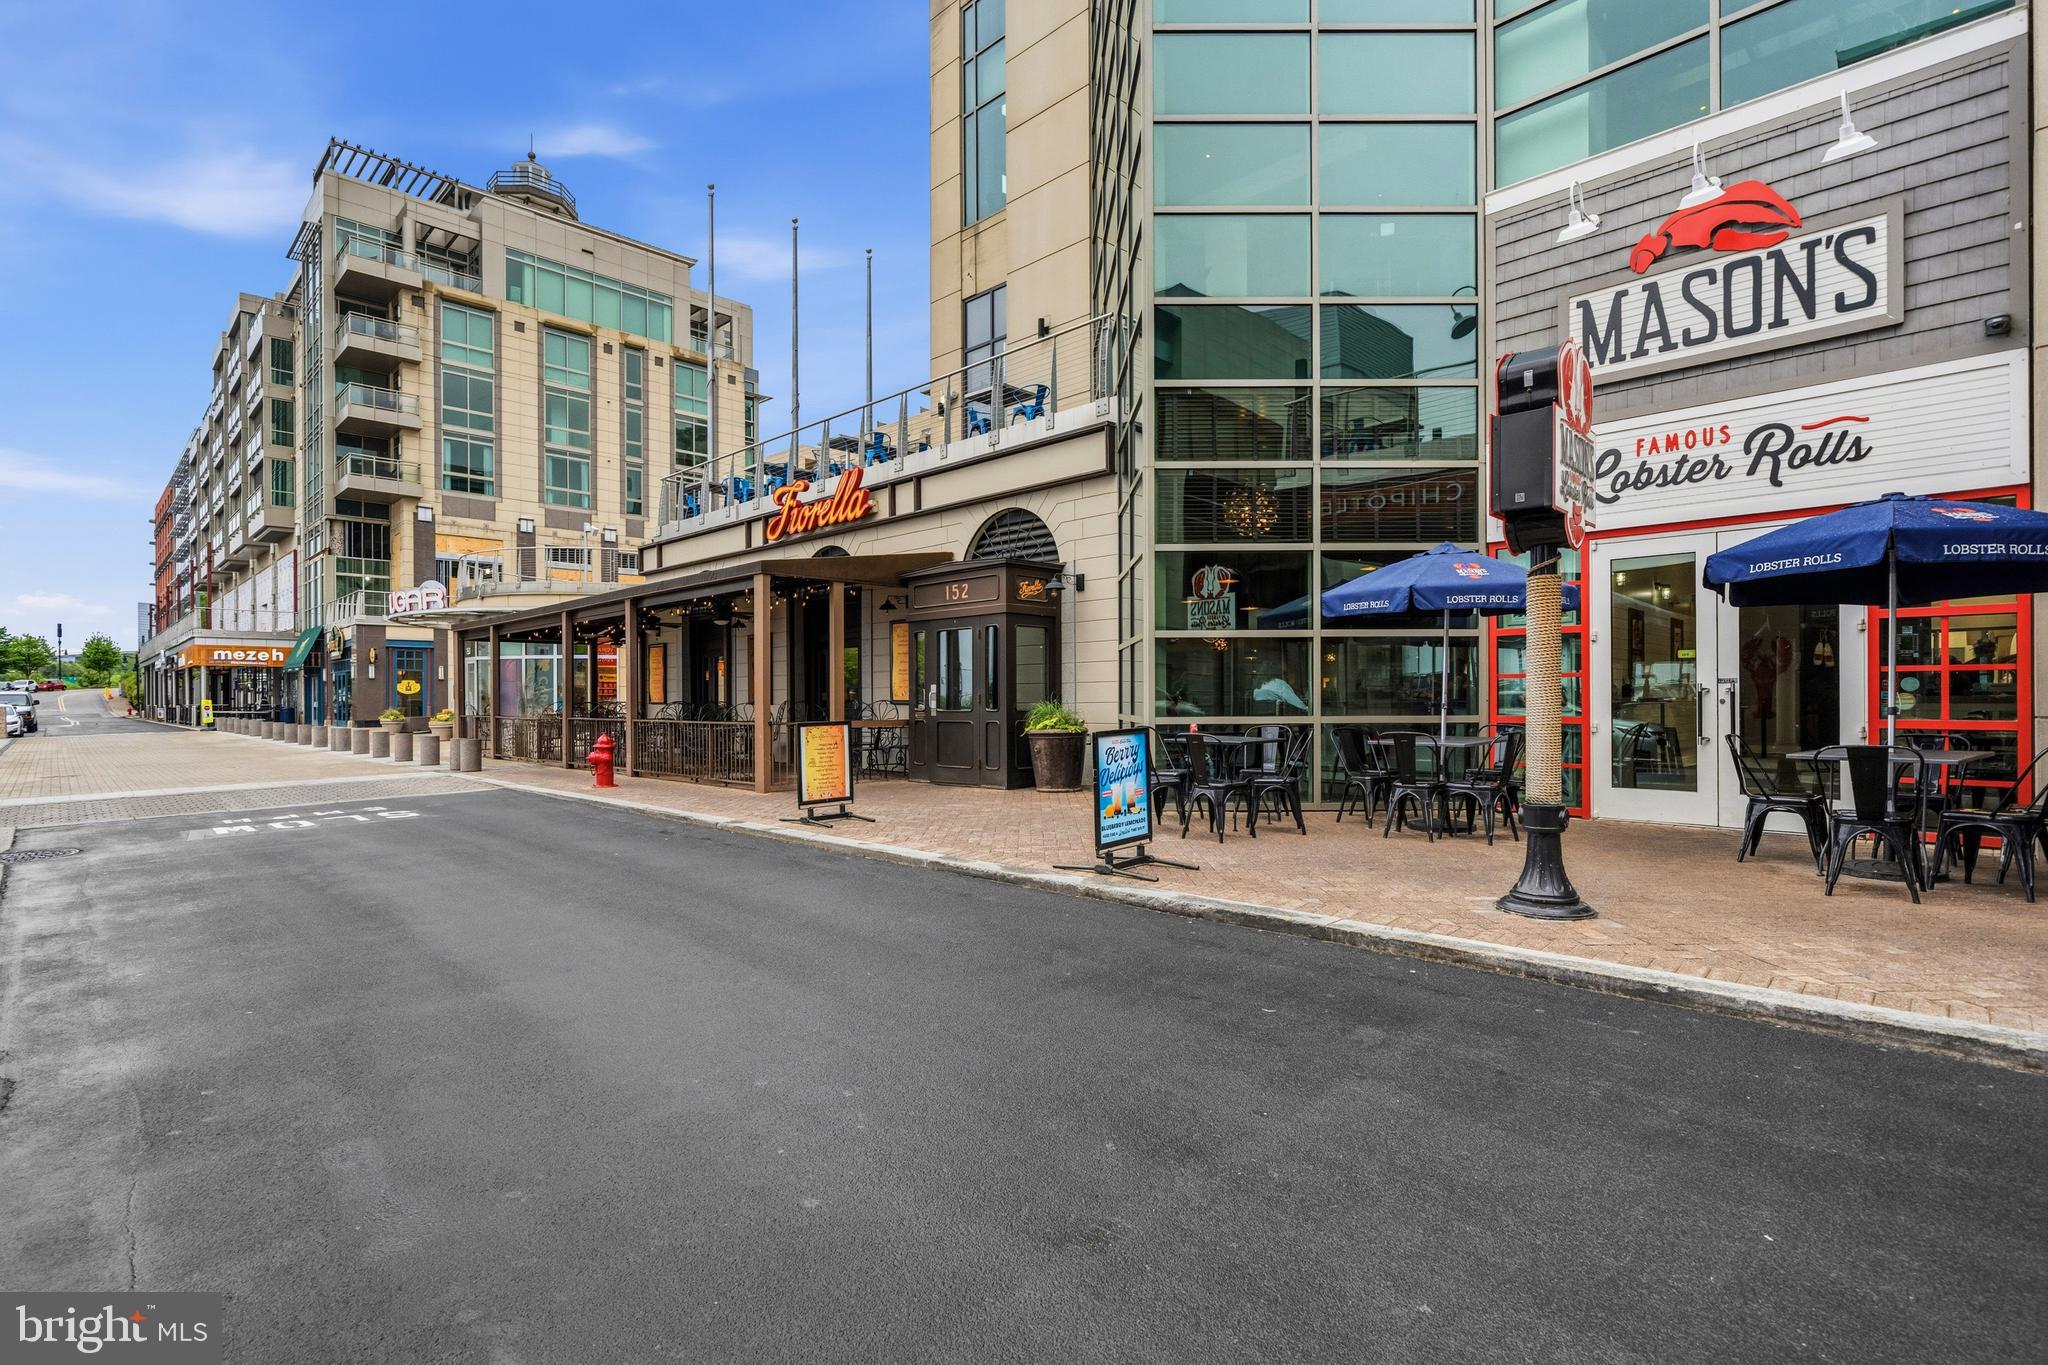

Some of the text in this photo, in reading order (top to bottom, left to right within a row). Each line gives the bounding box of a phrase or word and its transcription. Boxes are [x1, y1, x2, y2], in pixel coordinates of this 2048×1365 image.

[1576, 226, 1878, 368] MASON'S
[1636, 424, 1731, 457] FAMOUS
[1596, 448, 1733, 502] Lobster
[1744, 422, 1873, 488] Rolls
[767, 467, 873, 541] Fiorella
[1944, 544, 2005, 555] LOBSTER
[1750, 553, 1841, 573] LOBSTER ROLLS
[945, 584, 969, 600] 152
[1446, 595, 1518, 604] LOBSTER ROLLS
[1343, 600, 1389, 610] LOBSTER ROLLS
[213, 648, 284, 662] mezeh
